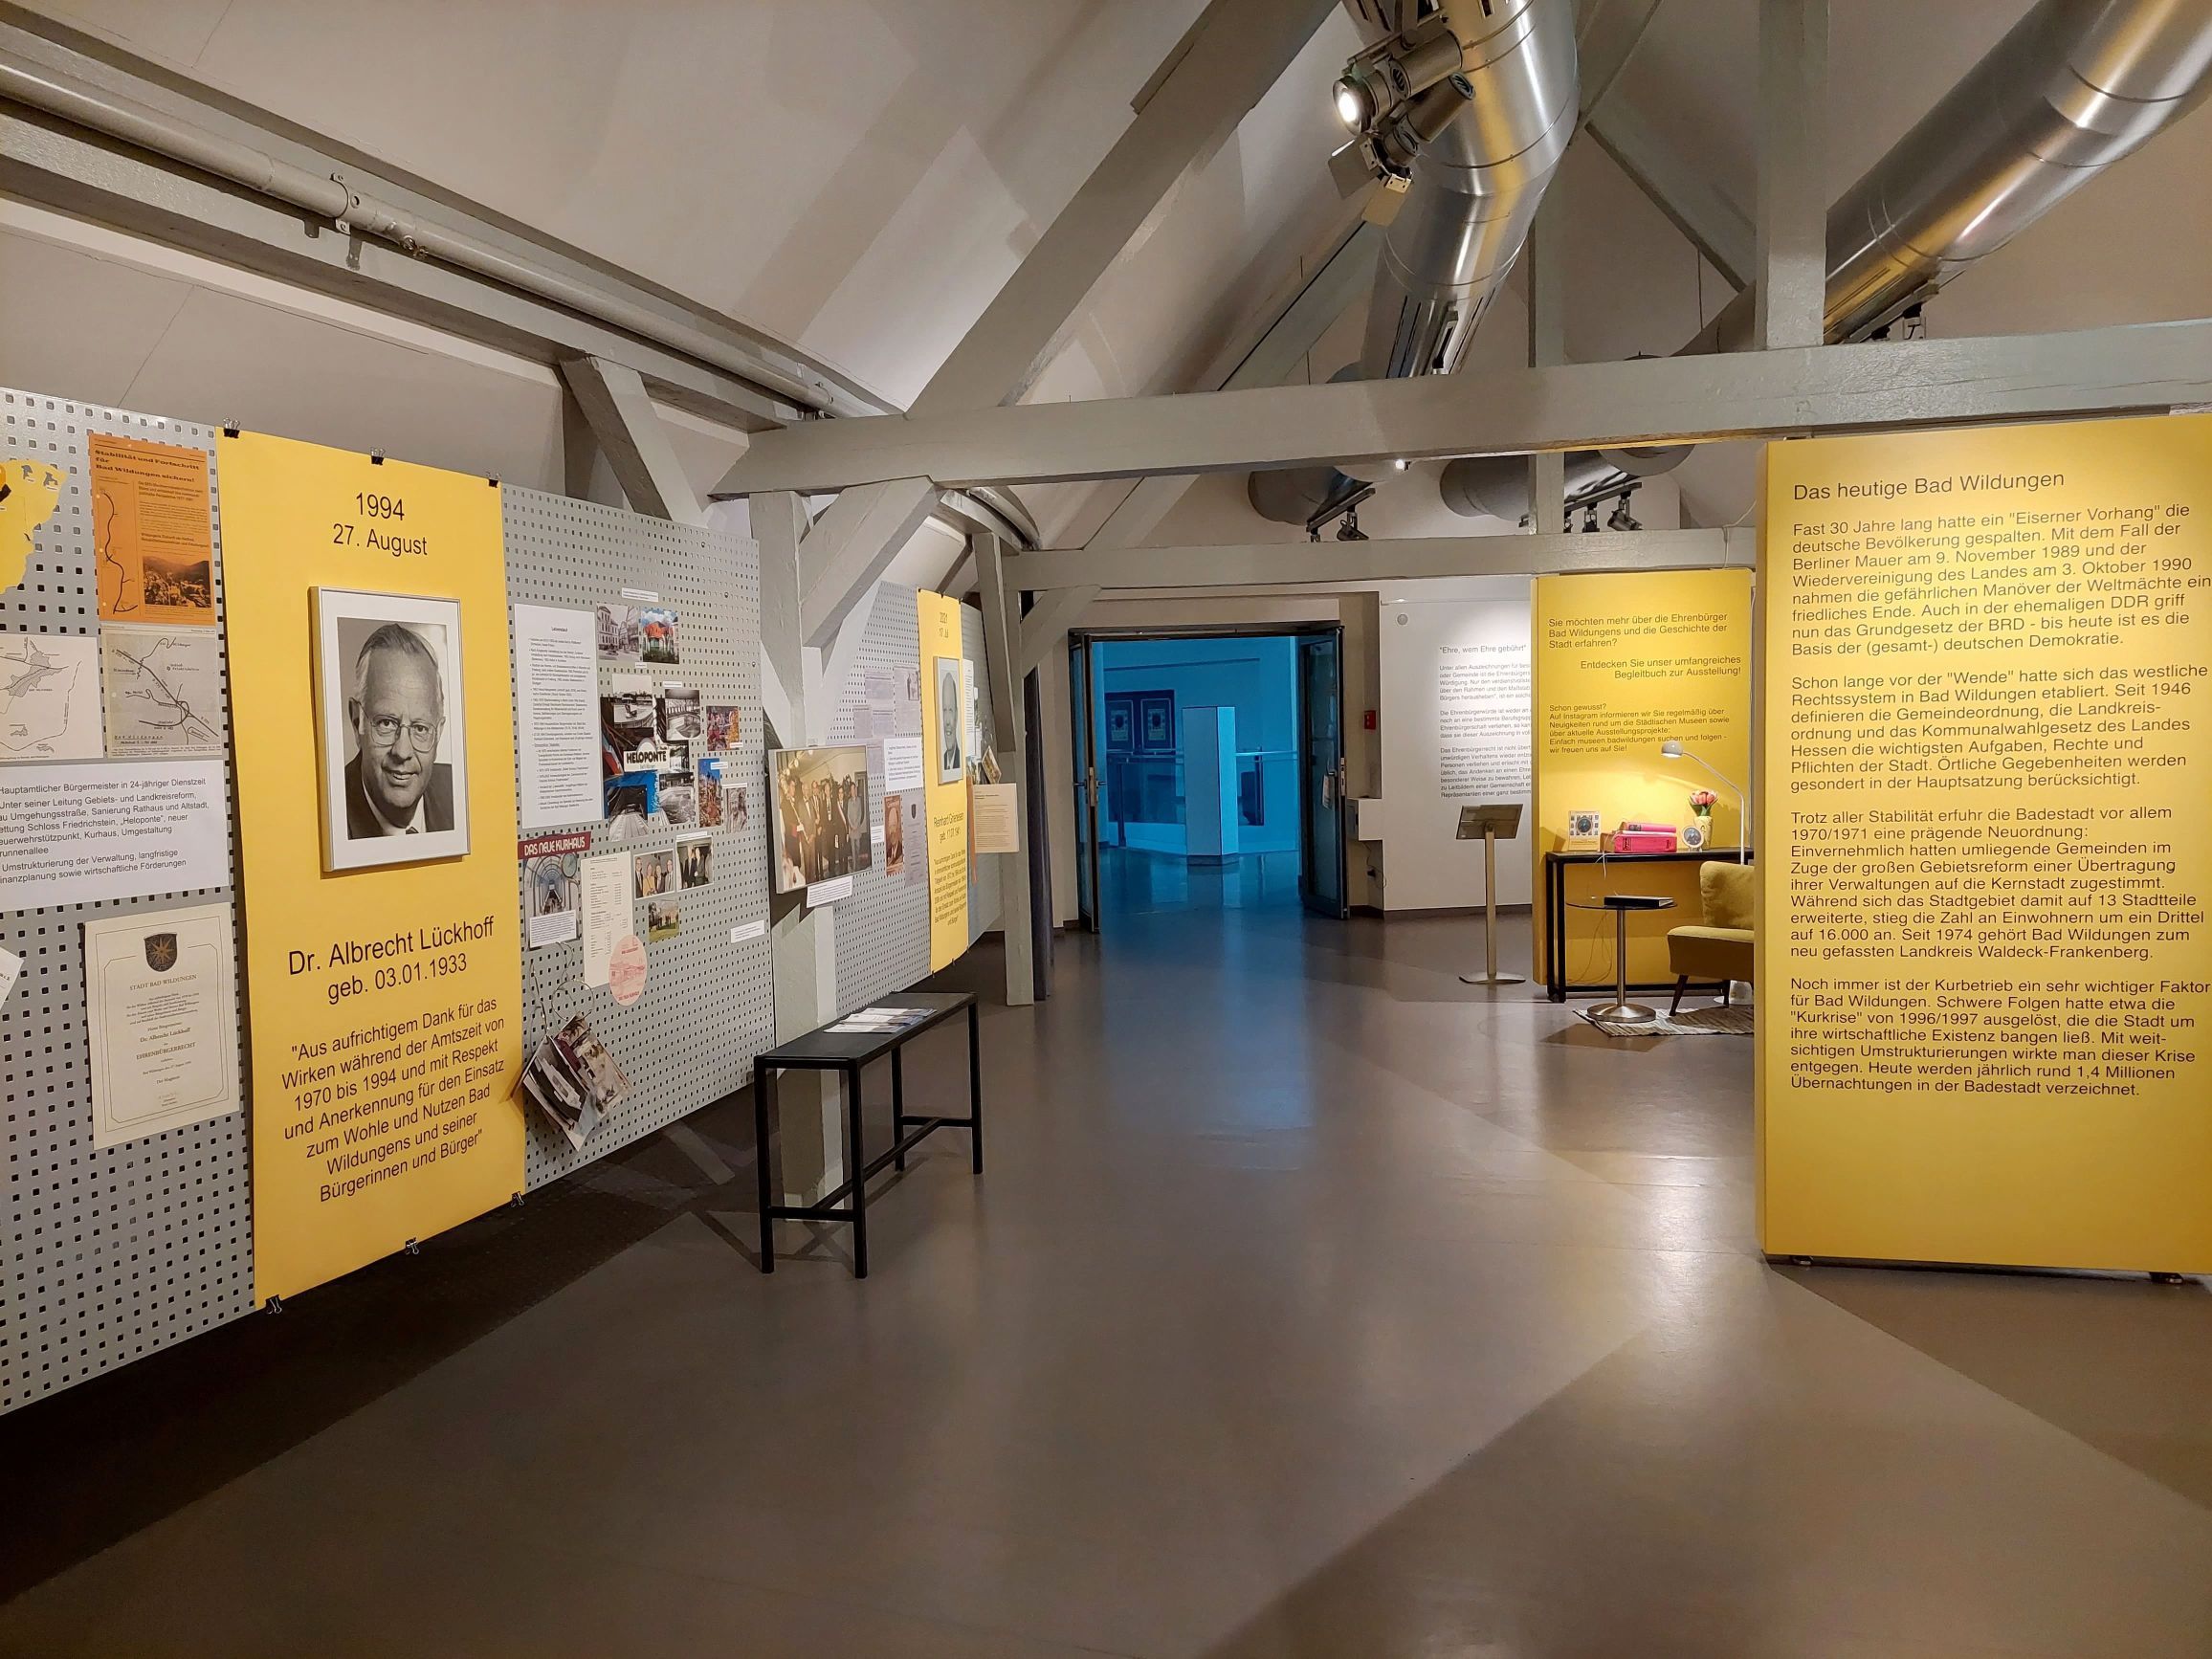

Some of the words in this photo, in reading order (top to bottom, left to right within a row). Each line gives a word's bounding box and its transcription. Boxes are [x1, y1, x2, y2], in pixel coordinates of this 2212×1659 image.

[1794, 483, 1829, 500] Das
[1838, 478, 1907, 501] heutige
[1915, 476, 1951, 494] Bad
[1959, 471, 2063, 496] Wildungen
[356, 493, 404, 520] 1994
[1794, 521, 1825, 535] Fast
[1830, 520, 1847, 533] 30
[1853, 518, 1894, 532] Jahre
[1901, 517, 1932, 533] lang
[1938, 514, 1975, 528] hatte
[1981, 513, 2002, 526] ein
[2009, 509, 2081, 524] "Eiserner
[2088, 505, 2159, 523] Vorhang"
[2166, 503, 2189, 517] die
[333, 523, 359, 545] 27.
[366, 528, 427, 556] August
[1793, 538, 1860, 553] deutsche
[1866, 533, 1958, 552] Bevölkerung
[1965, 528, 2044, 547] gespalten.
[2052, 527, 2073, 541] Mit
[2080, 525, 2113, 539] dem
[2121, 523, 2148, 537] Fall
[2155, 522, 2179, 536] der
[1794, 555, 1849, 570] Berliner
[1855, 553, 1902, 567] Mauer
[1908, 554, 1930, 564] am
[1936, 550, 1948, 564] 9.
[1957, 546, 2035, 563] November
[2043, 544, 2079, 558] 1989
[2086, 542, 2113, 556] und
[2120, 542, 2146, 554] der
[1793, 569, 1932, 590] Wiedervereinigung
[1937, 567, 1964, 581] des
[1971, 564, 2026, 580] Landes
[2033, 566, 2056, 577] am
[2063, 563, 2075, 576] 3.
[2082, 560, 2145, 575] Oktober
[2154, 558, 2191, 572] 1990
[1793, 589, 1851, 605] nahmen
[1857, 588, 1879, 602] die
[1885, 585, 1977, 604] gefährlichen
[1983, 582, 2050, 596] Manöver
[2056, 580, 2081, 593] der
[2087, 576, 2181, 592] Weltmächte
[2187, 575, 2210, 587] ein
[1569, 628, 1621, 638] Wildungens
[1659, 625, 1709, 633] Geschichte
[1671, 613, 1727, 624] Ehrenbürger
[1581, 660, 1626, 669] Entdecken
[1675, 656, 1740, 667] umfangreiches
[1614, 670, 1666, 680] Begleitbuch
[1686, 667, 1740, 677] Ausstellung!
[1574, 703, 1606, 712] gewusst?
[627, 751, 666, 763] HELOPONTE
[64, 783, 119, 792] Bürgermeister
[11, 809, 88, 821] Umgehungsstraße,
[524, 843, 538, 855] DAS
[556, 837, 585, 851] KURHAUS
[289, 950, 320, 974] Dr.
[329, 932, 412, 966] Albrecht
[420, 916, 493, 949] Lückhoff
[328, 975, 367, 1004] geb.
[375, 953, 466, 988] 03.01.1933
[292, 1043, 326, 1060] "Aus
[332, 1020, 417, 1051] aufrichtigem
[423, 1007, 453, 1028] Dank
[458, 1004, 473, 1018] für
[476, 999, 496, 1012] das
[136, 1041, 196, 1060] EHRENBÜRGERRECHT
[281, 1065, 334, 1089] Wirken
[340, 1044, 400, 1073] während
[406, 1040, 427, 1054] der
[431, 1022, 481, 1049] Amtszeit
[485, 1018, 503, 1031] von
[295, 1087, 331, 1110] 1970
[337, 1081, 357, 1098] bis
[364, 1069, 395, 1090] 1994
[402, 1060, 425, 1079] und
[430, 1054, 448, 1071] mit
[453, 1039, 497, 1064] Respekt
[285, 1117, 313, 1139] und
[319, 1090, 413, 1129] Anerkennung
[418, 1082, 434, 1097] für
[438, 1075, 460, 1091] den
[465, 1060, 503, 1082] Einsatz
[306, 1138, 338, 1157] zum
[343, 1120, 388, 1144] Wohle
[394, 1108, 417, 1128] und
[423, 1095, 464, 1118] Nutzen
[469, 1083, 489, 1102] Bad
[327, 1138, 409, 1174] Wildungens
[415, 1123, 437, 1144] und
[442, 1113, 476, 1135] seiner
[321, 1161, 407, 1201] Bürgerinnen
[412, 1147, 435, 1167] und
[440, 1129, 481, 1158] Bürger"
